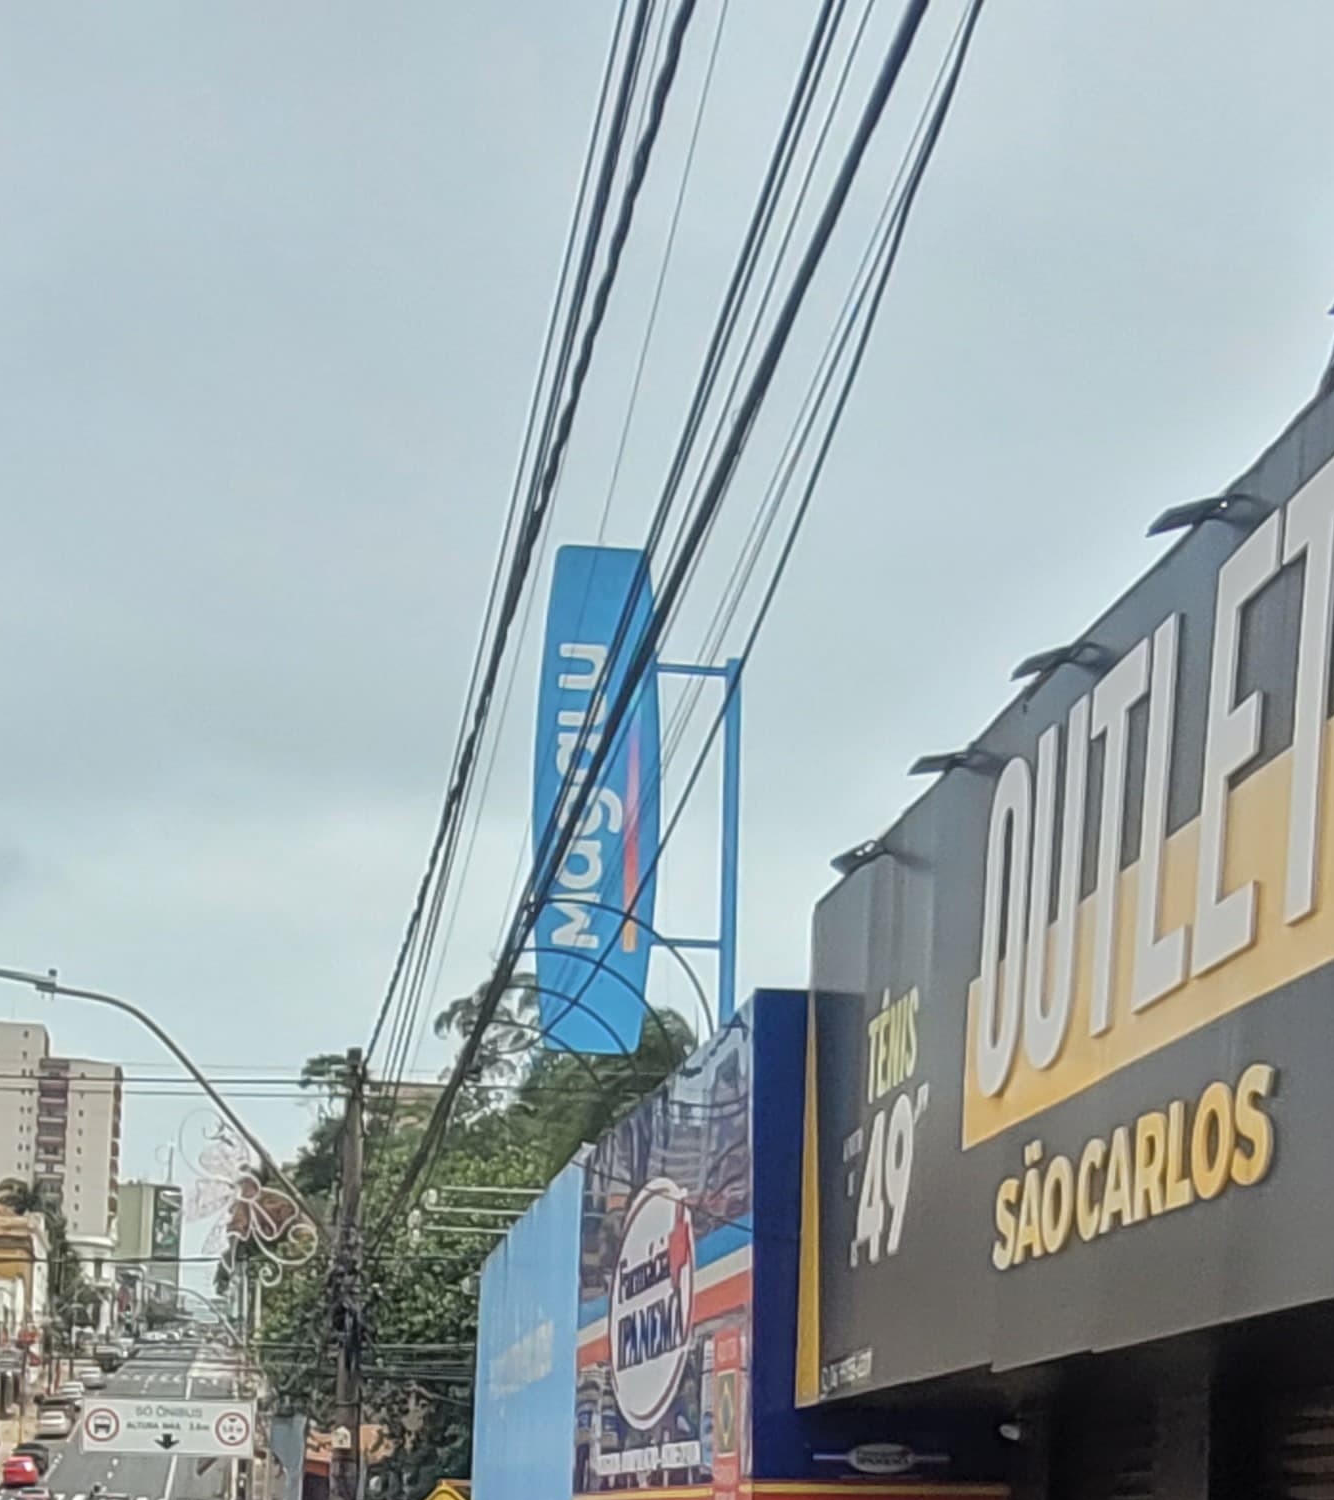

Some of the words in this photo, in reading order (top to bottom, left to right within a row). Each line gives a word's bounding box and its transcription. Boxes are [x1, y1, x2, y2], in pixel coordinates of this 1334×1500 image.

[552, 643, 624, 950] Magalu
[992, 1139, 1073, 1272] SÃO
[1075, 1063, 1279, 1246] CARLOS
[618, 1287, 685, 1371] IPANEMA
